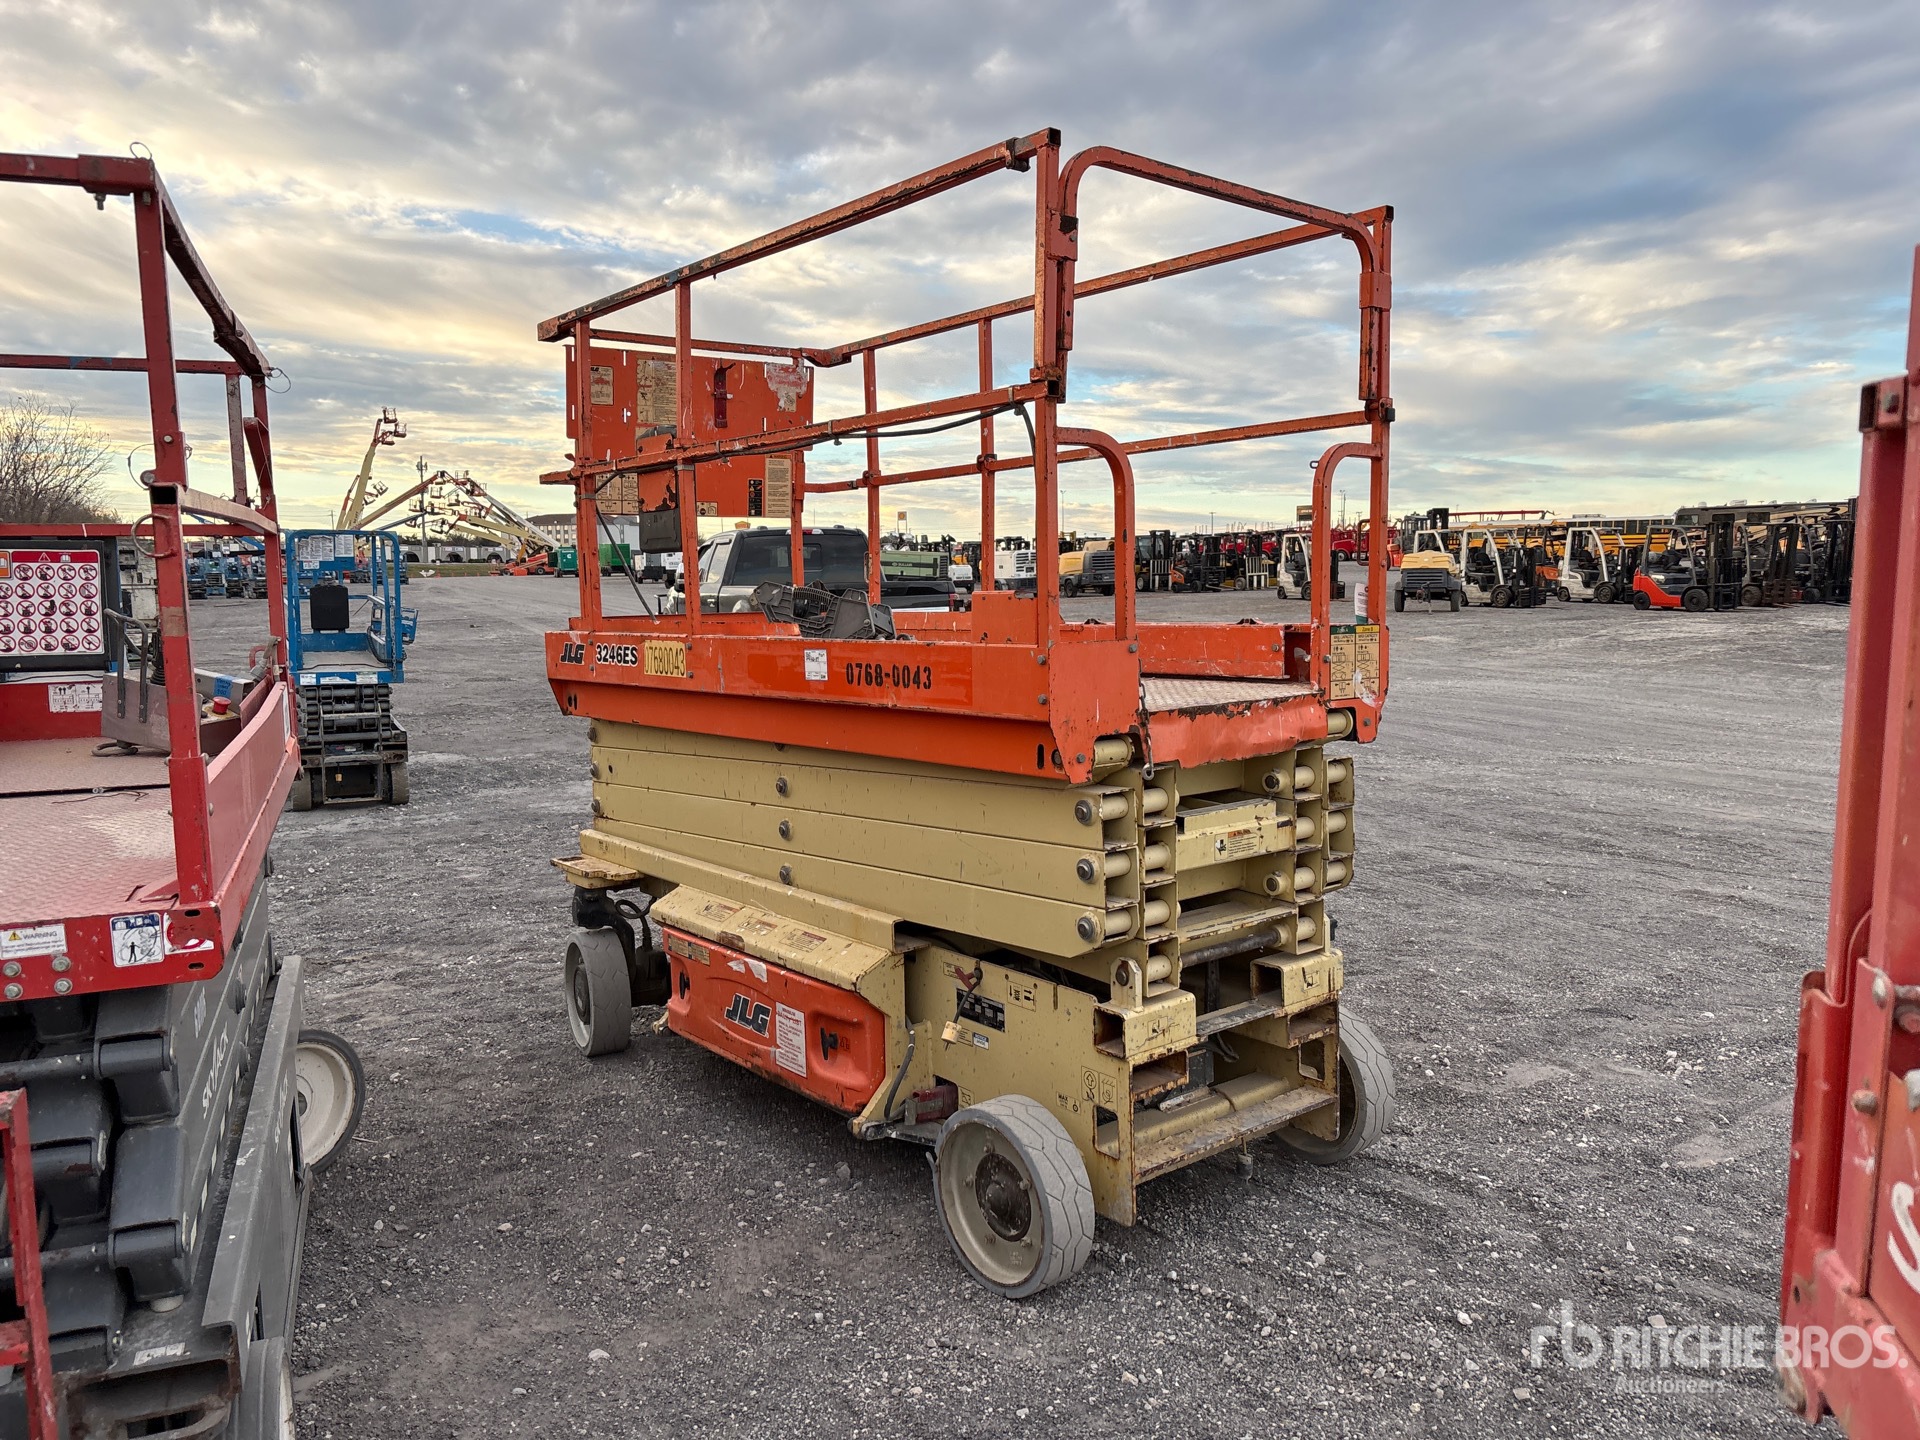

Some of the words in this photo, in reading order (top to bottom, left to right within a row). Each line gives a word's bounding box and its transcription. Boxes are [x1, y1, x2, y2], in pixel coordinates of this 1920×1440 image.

[559, 641, 586, 665] JLG
[595, 642, 639, 667] 3246ES
[645, 645, 686, 677] 07680043
[845, 662, 932, 690] 0768-0043
[23, 931, 58, 939] WARNING
[724, 992, 772, 1038] JLG
